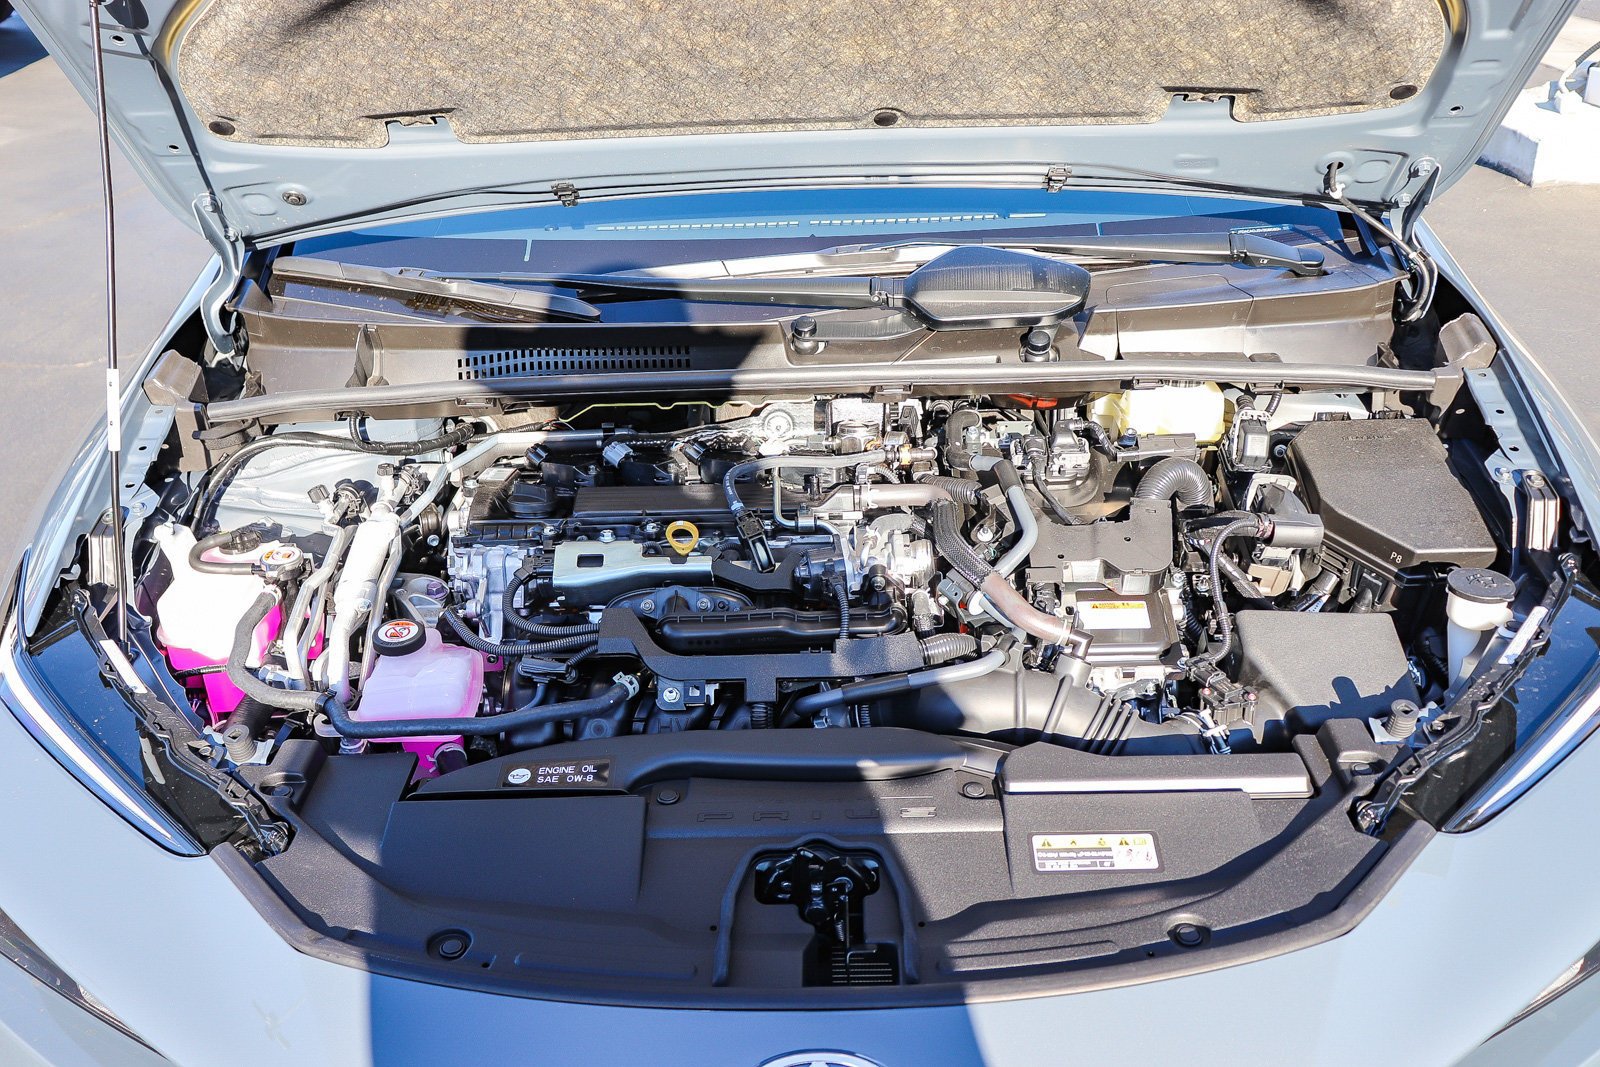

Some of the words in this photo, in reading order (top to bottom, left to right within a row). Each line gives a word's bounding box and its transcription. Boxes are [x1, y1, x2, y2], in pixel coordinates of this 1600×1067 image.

[1390, 551, 1403, 564] P8
[538, 765, 576, 775] ENGINE
[581, 764, 598, 773] OIL
[536, 775, 560, 784] SAE
[566, 774, 594, 783] 0W-8
